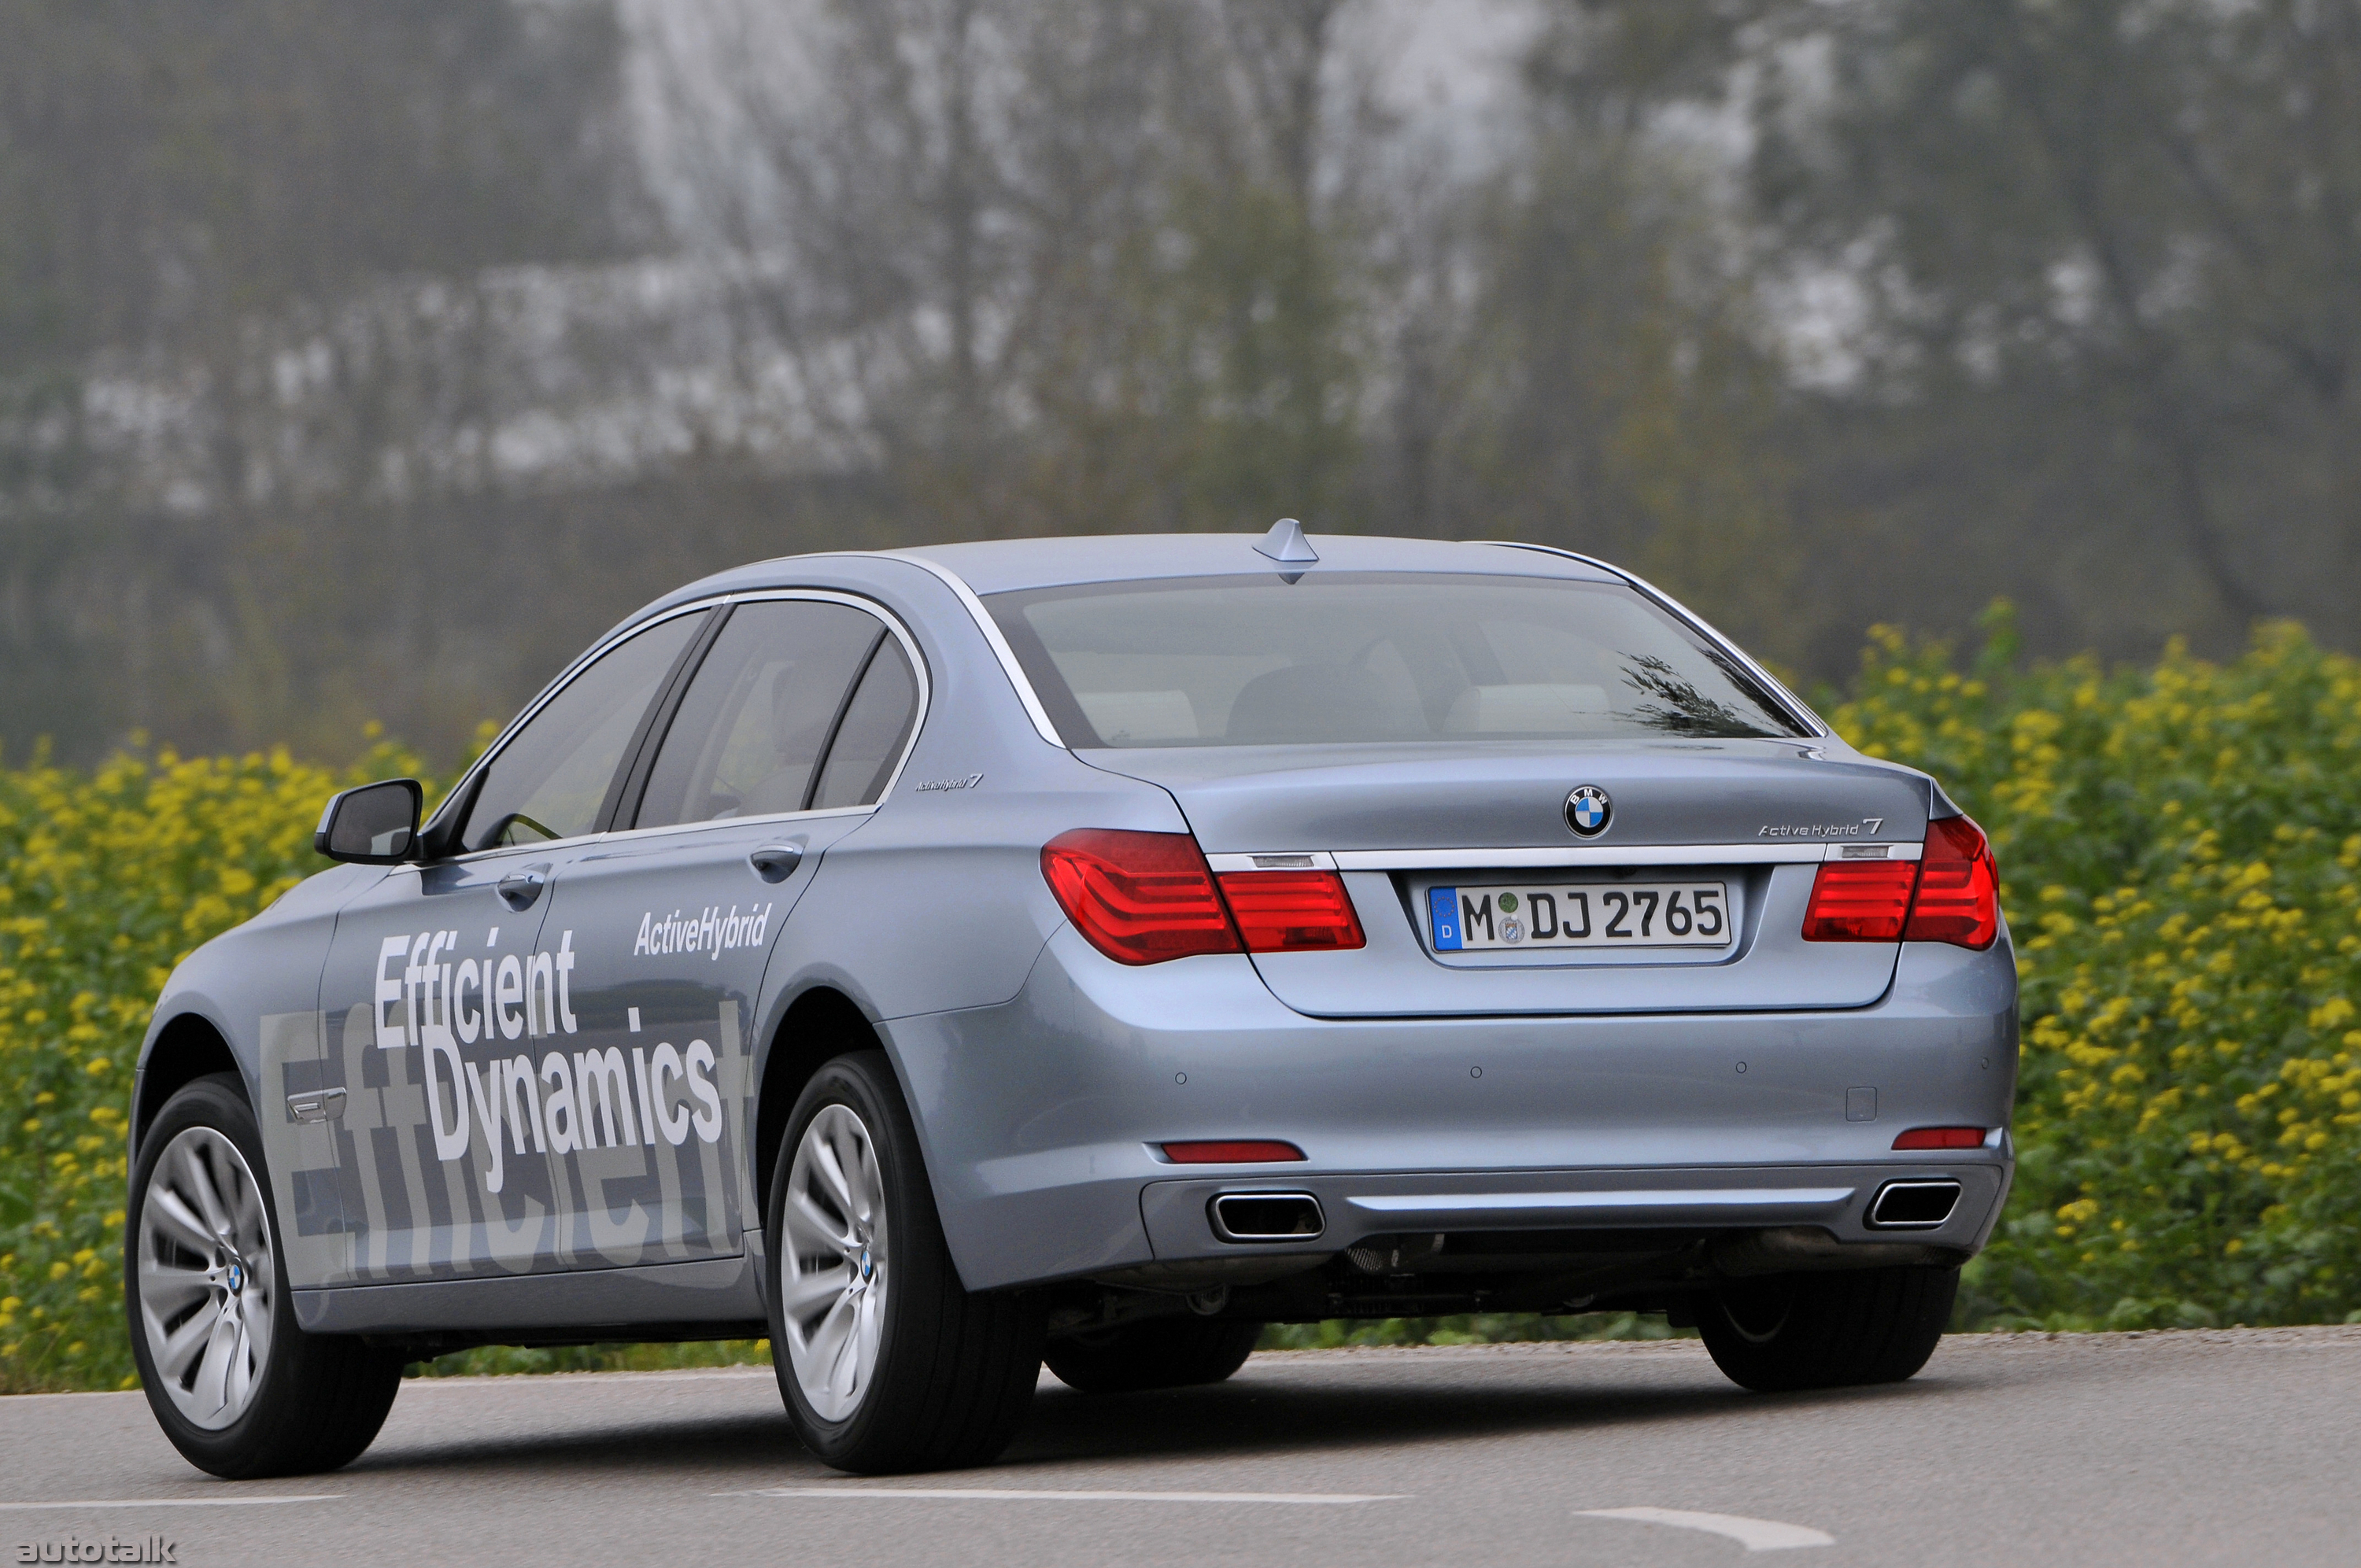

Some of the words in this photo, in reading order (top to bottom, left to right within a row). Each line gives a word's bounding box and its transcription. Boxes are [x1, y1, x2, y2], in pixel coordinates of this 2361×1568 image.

[970, 773, 984, 788] 7
[1570, 788, 1607, 805] BMW
[1862, 817, 1883, 835] 7
[634, 902, 772, 961] ActiveHybrid
[1442, 925, 1452, 939] D
[1461, 894, 1495, 941] M
[1527, 892, 1591, 939] DJ
[1602, 890, 1721, 937] 2765
[375, 927, 577, 1049] Efficient
[422, 1007, 722, 1194] Dynamics
